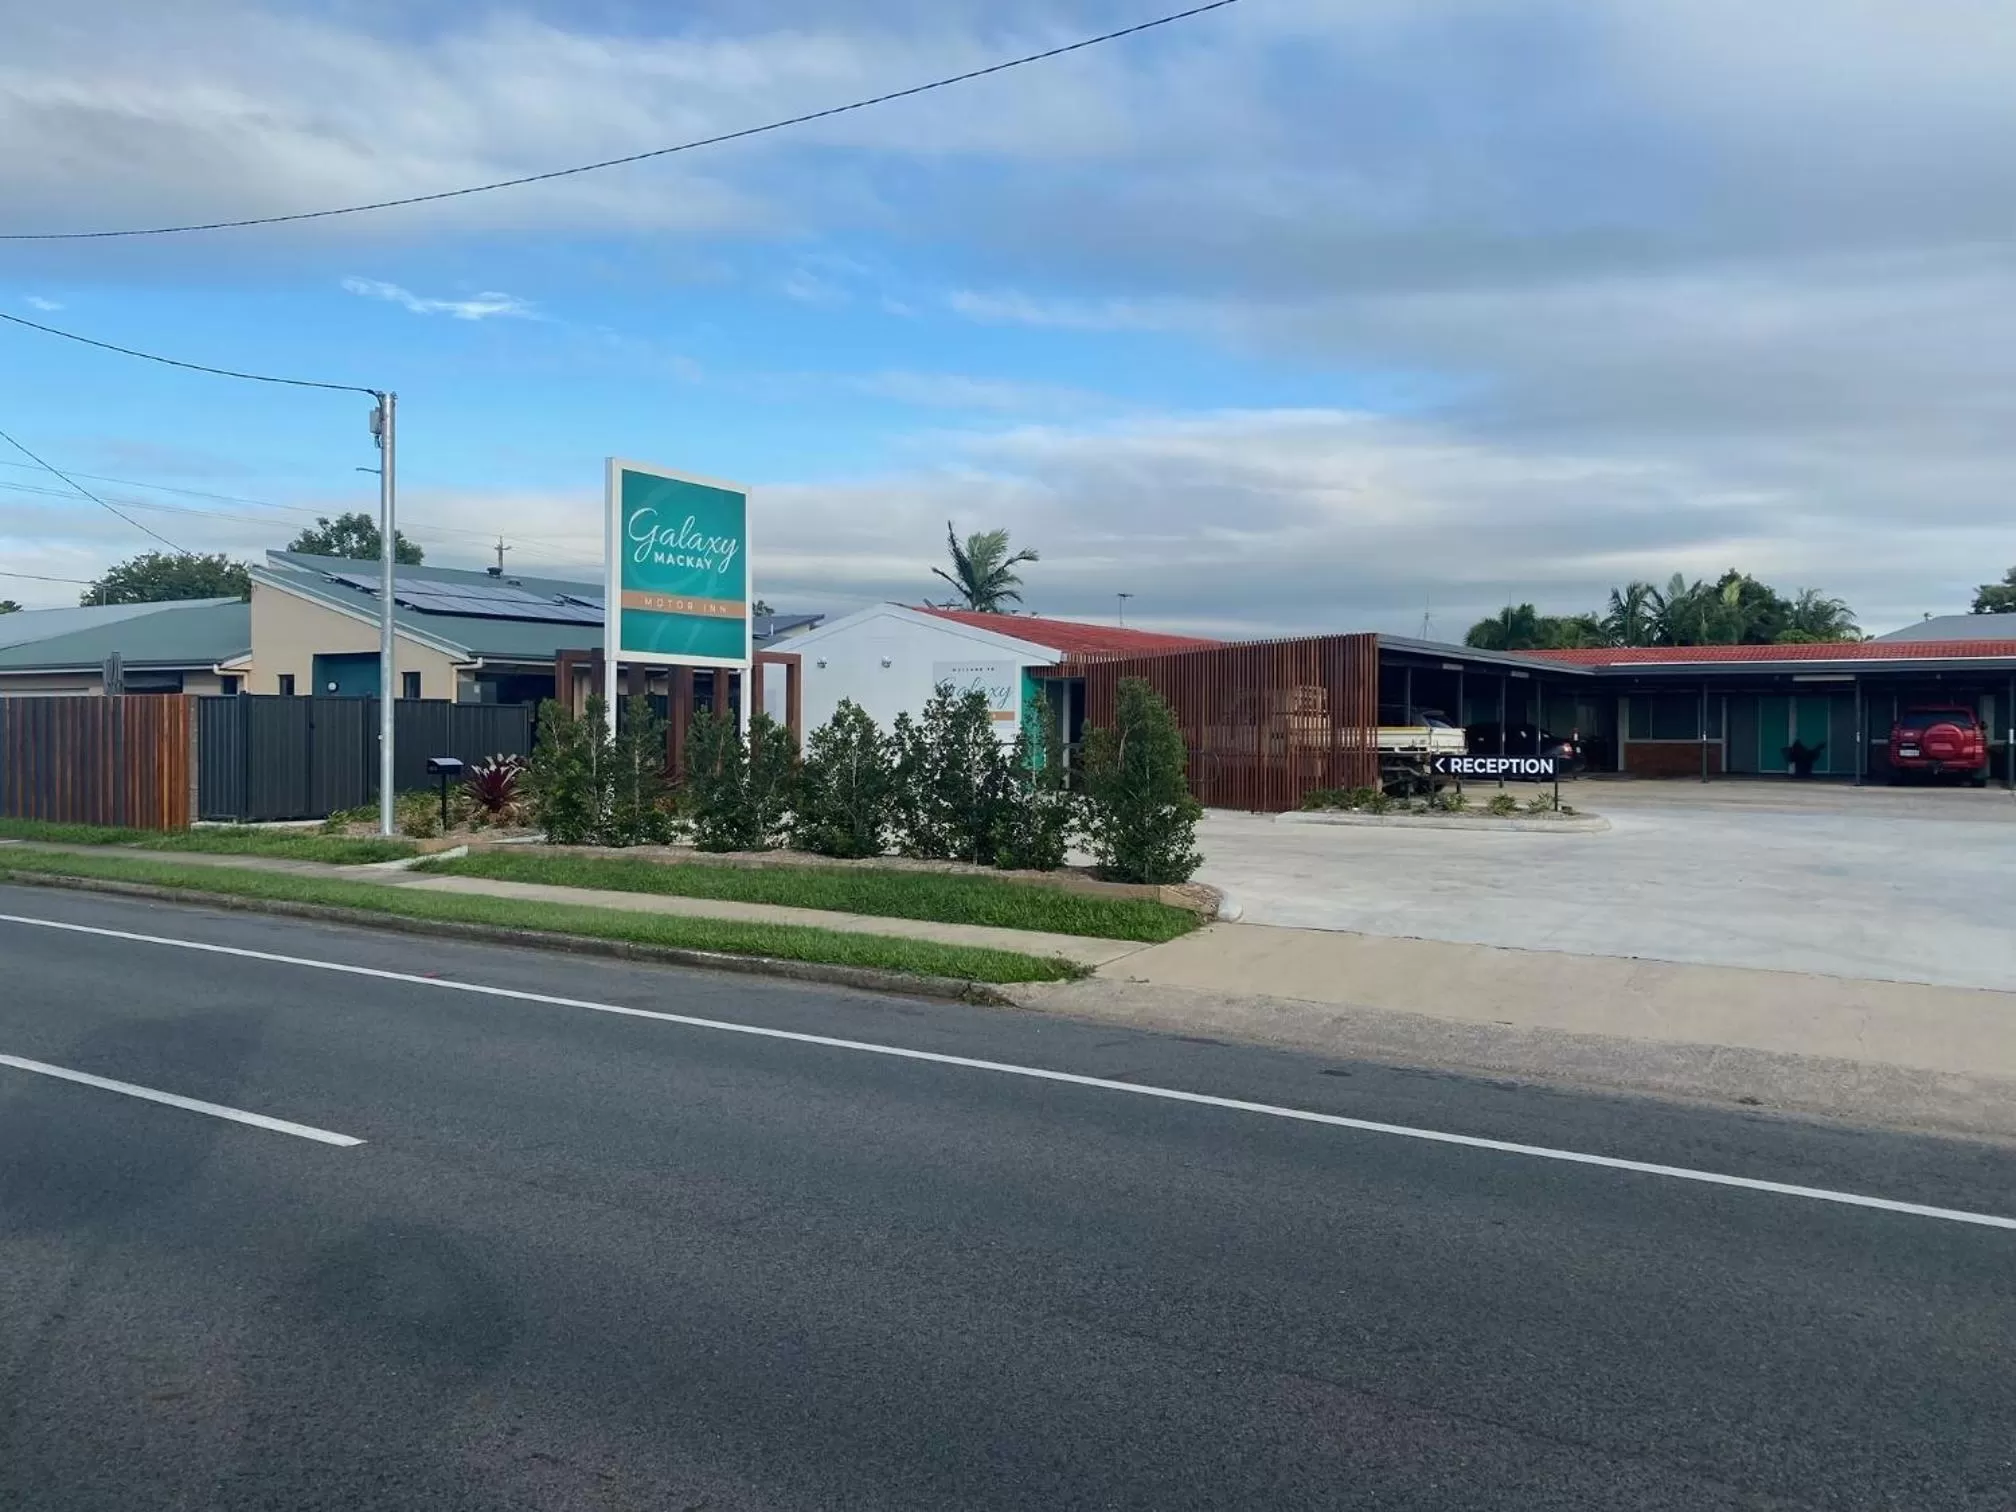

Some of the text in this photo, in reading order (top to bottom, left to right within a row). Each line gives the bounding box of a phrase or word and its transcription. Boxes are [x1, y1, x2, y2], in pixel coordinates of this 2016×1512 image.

[628, 507, 739, 573] Galaxy
[654, 552, 712, 570] MACKAY
[644, 597, 727, 615] MOTOR INN
[1451, 757, 1554, 774] RECEPTION
